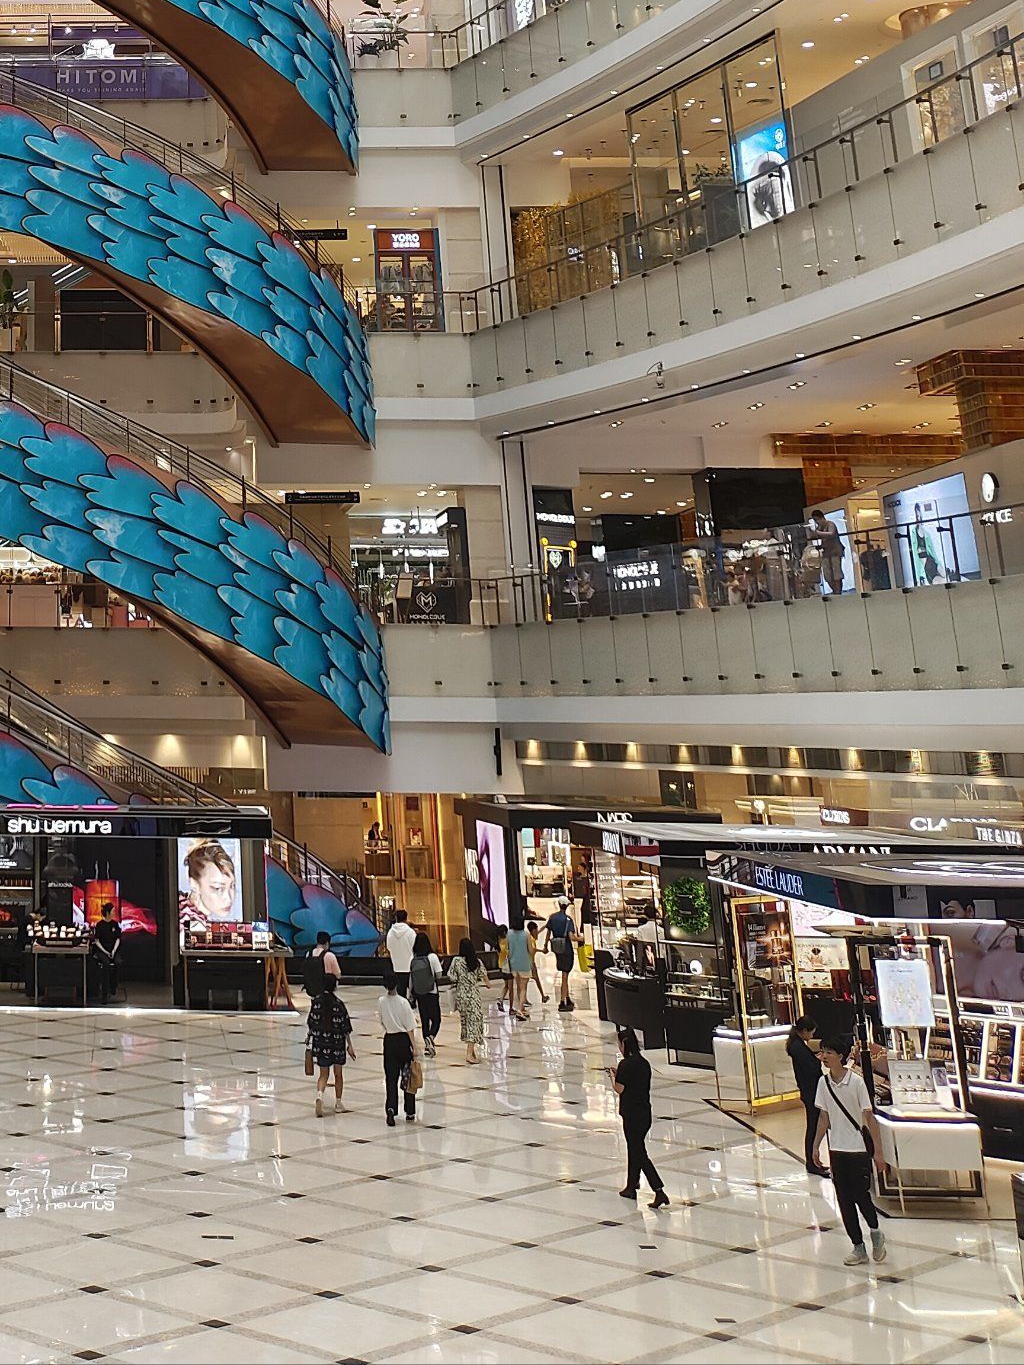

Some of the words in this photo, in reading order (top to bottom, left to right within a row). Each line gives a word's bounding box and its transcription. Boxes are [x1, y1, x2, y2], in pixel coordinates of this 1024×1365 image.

[7, 817, 39, 833] shu
[44, 819, 112, 833] uemura
[976, 826, 994, 842] THE
[775, 871, 804, 896] LAUDER
